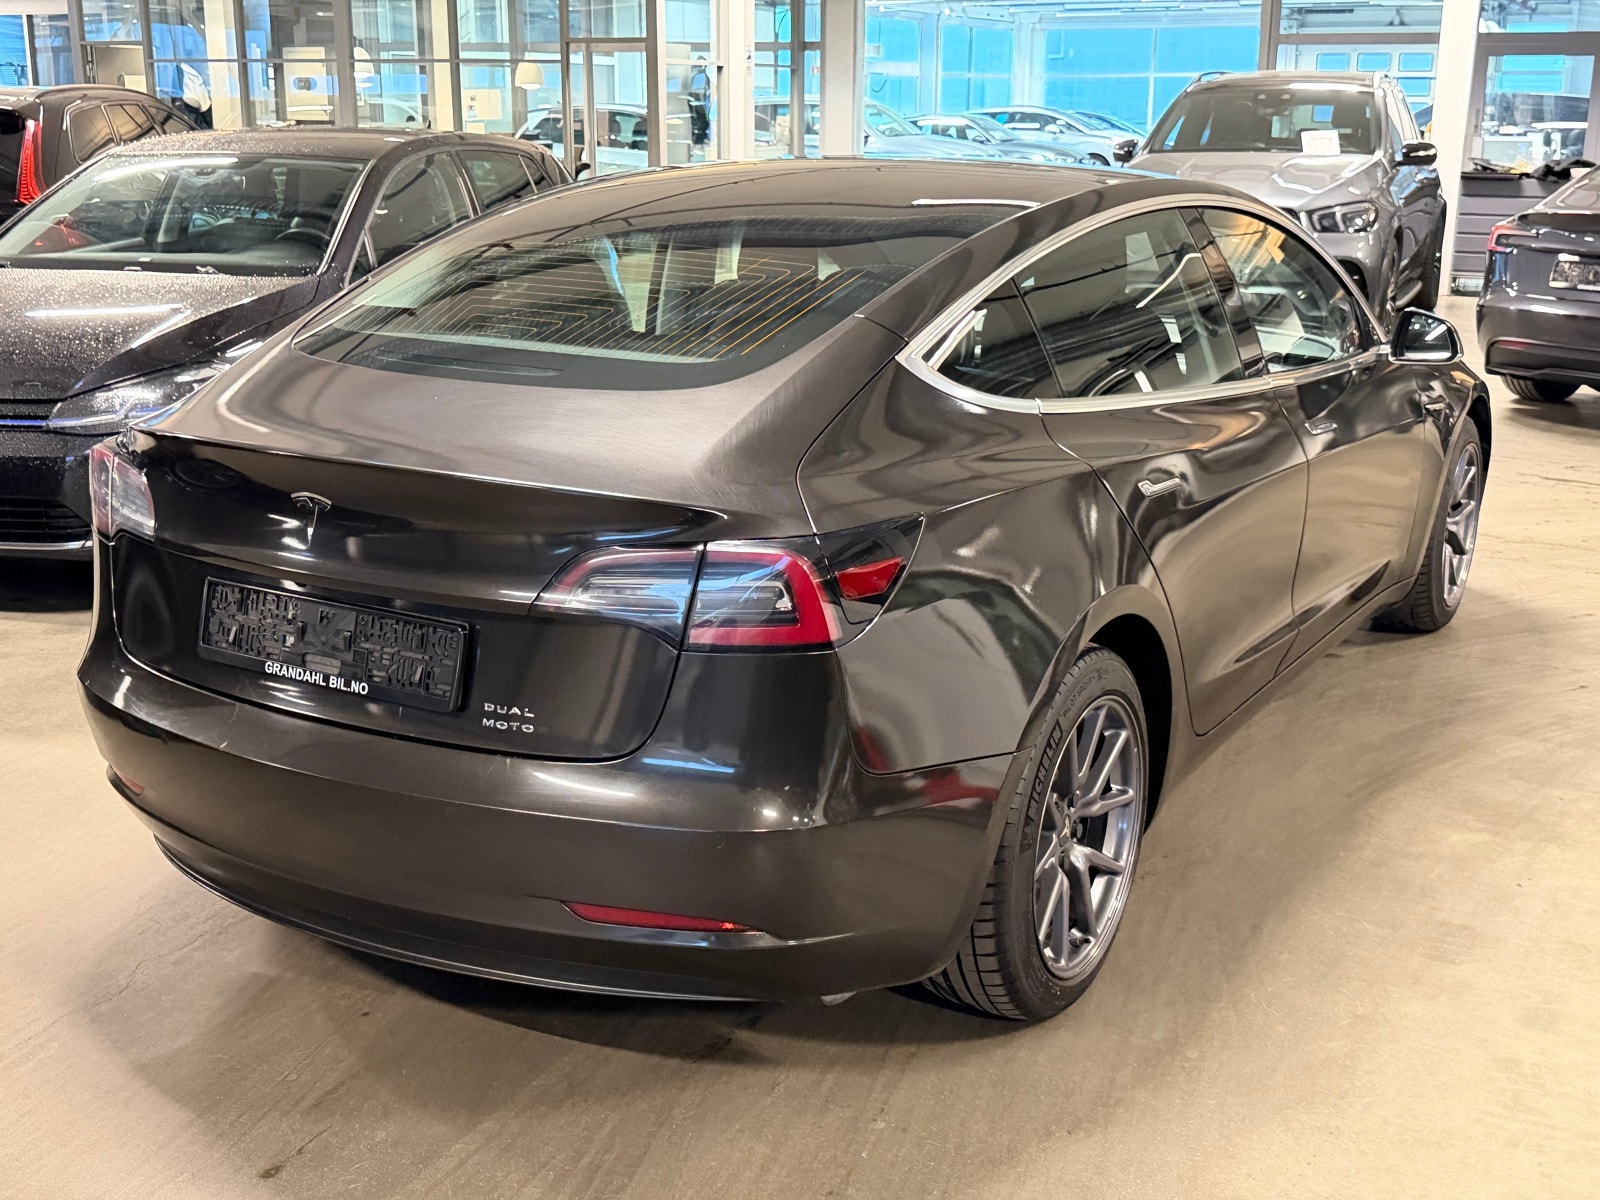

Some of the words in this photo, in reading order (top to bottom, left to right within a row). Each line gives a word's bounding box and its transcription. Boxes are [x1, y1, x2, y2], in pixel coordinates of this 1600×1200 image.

[264, 661, 326, 686] GRANDAHL
[329, 675, 369, 695] BIL.NO
[484, 702, 535, 718] DUAL
[482, 717, 535, 733] MOTO
[1026, 724, 1062, 821] MICHELIN
